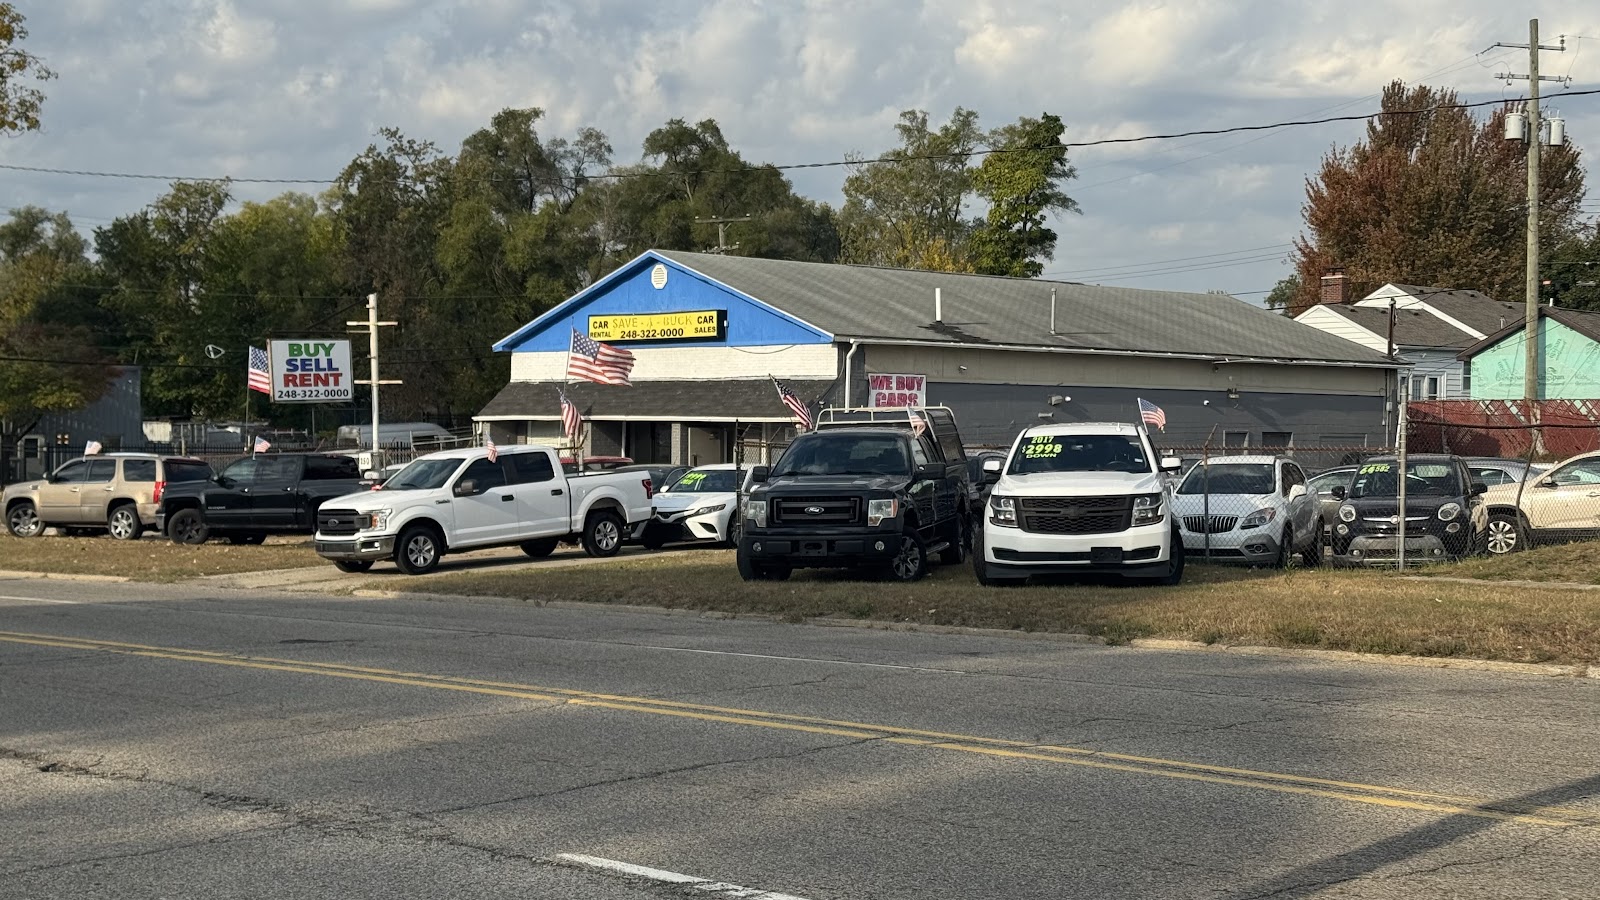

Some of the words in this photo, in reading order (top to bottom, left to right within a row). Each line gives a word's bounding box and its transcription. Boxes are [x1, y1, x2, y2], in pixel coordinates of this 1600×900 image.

[593, 321, 609, 329] CAR
[612, 317, 637, 328] SAVE
[663, 315, 692, 326] BUCK
[697, 316, 714, 324] CAR
[620, 328, 684, 339] 248-322-0000
[288, 343, 336, 357] BUY
[286, 358, 339, 372] SELL
[283, 373, 343, 387] RENT
[870, 375, 893, 390] WE
[895, 376, 925, 391] BUY
[277, 389, 349, 399] 248-322-0000
[875, 392, 919, 407] CARS
[1031, 436, 1055, 444] 2017
[1021, 444, 1062, 454] $2998
